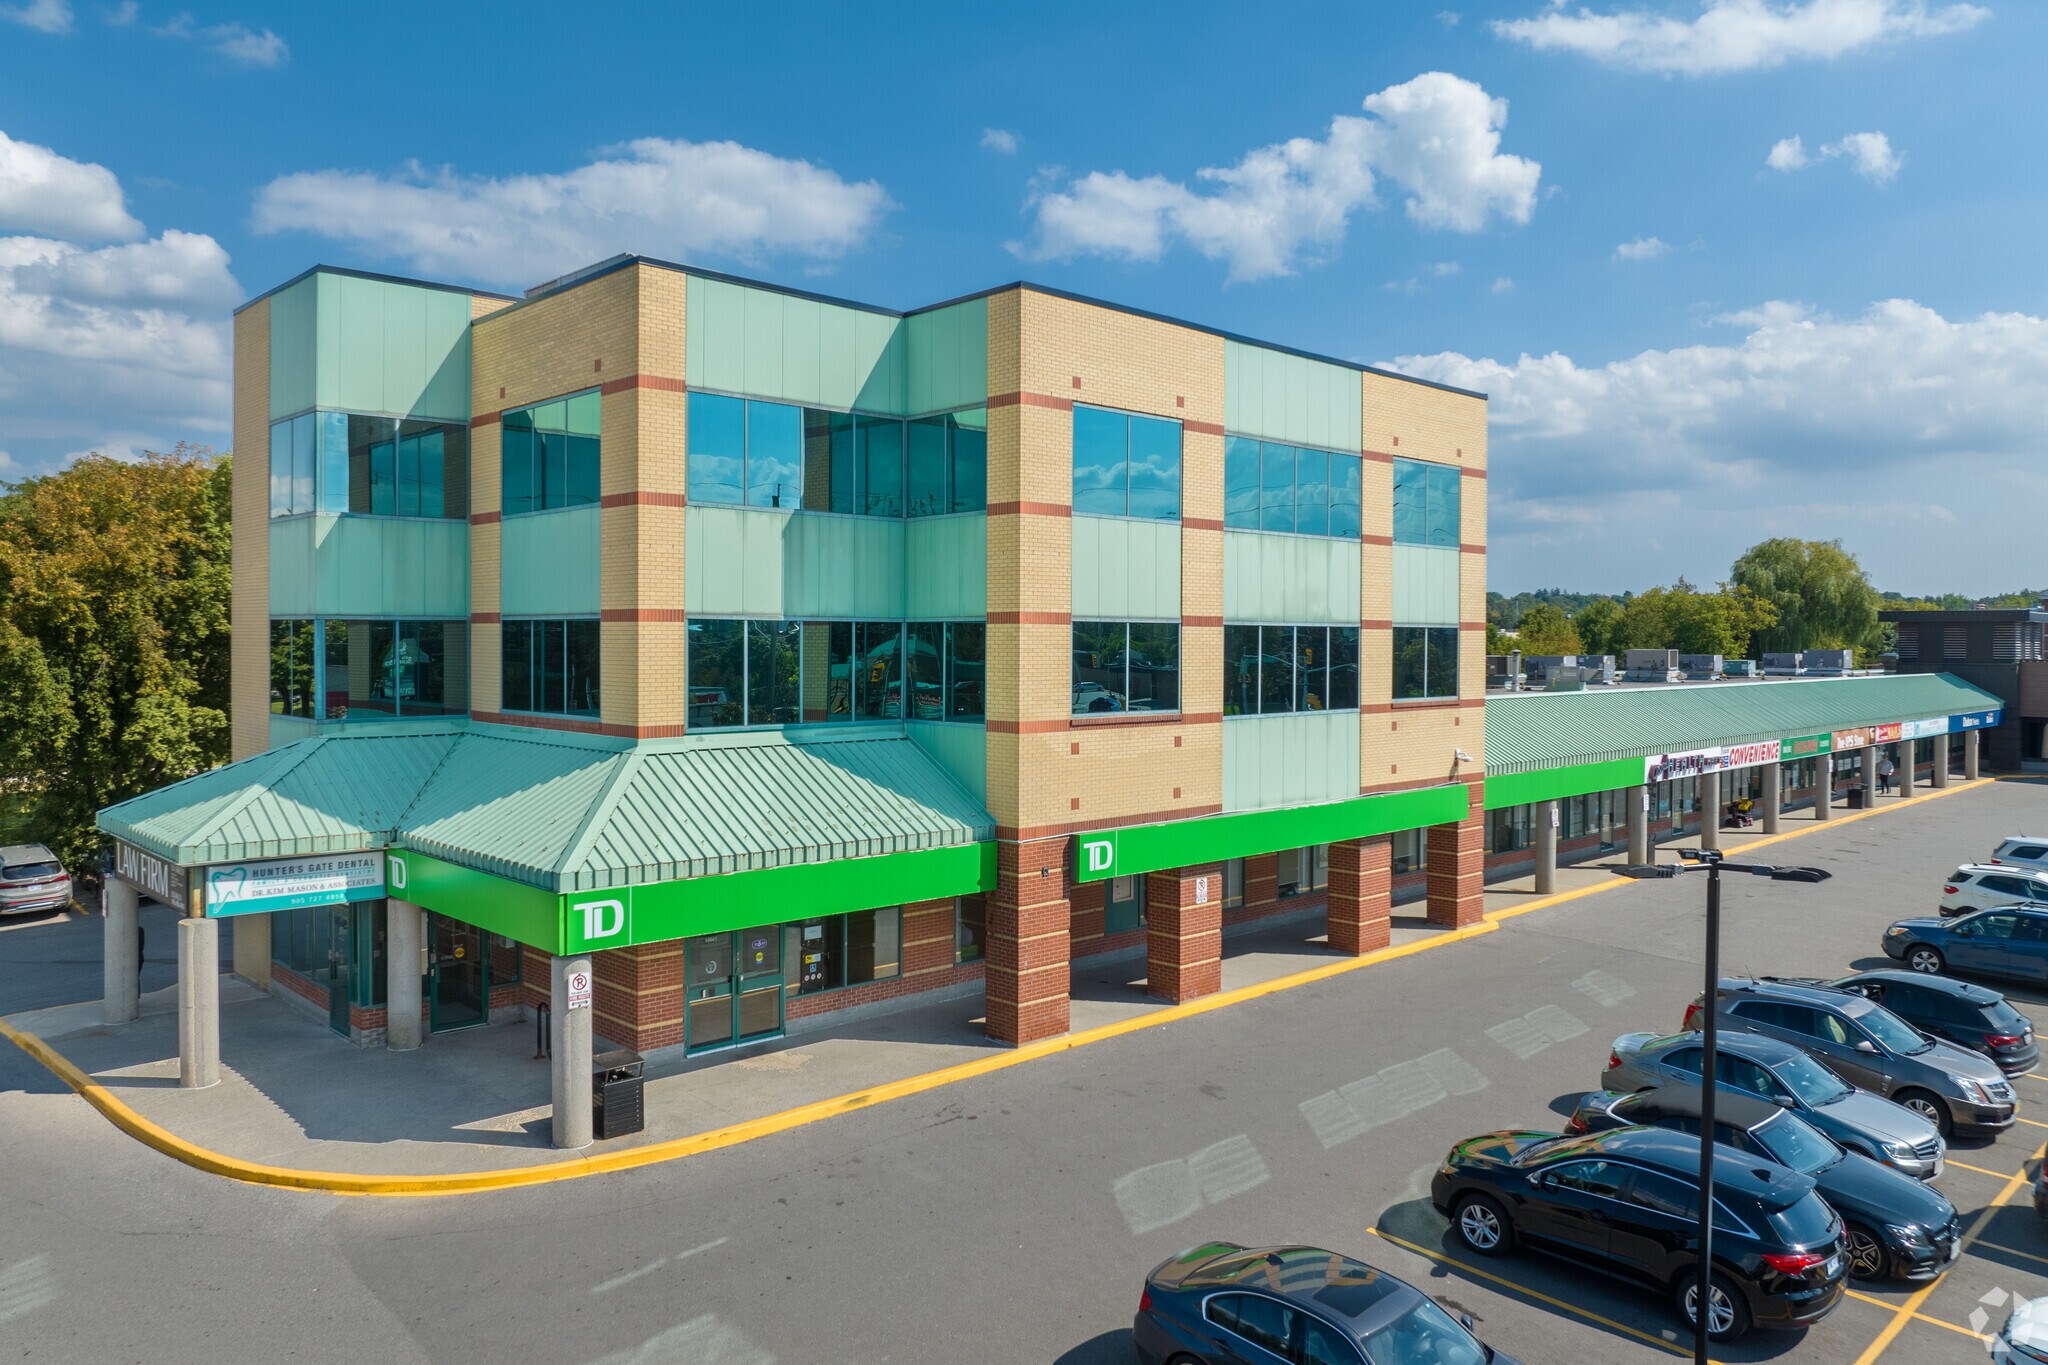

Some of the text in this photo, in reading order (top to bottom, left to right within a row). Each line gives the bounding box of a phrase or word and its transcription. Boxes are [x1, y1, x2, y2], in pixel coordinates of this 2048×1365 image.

[1668, 754, 1704, 773] HEALTH
[1729, 742, 1780, 766] CONVENIENCE
[252, 858, 376, 877] HUNTER'S GATE DENTAL
[1083, 840, 1113, 872] TD
[117, 842, 139, 882] LAW
[140, 853, 169, 897] FIRM
[388, 855, 406, 889] TD
[267, 886, 285, 895] KIM
[287, 884, 318, 894] MASON
[327, 878, 376, 889] ASSOCIATES
[291, 897, 305, 905] 905
[309, 895, 323, 903] 727
[573, 899, 624, 940] TD
